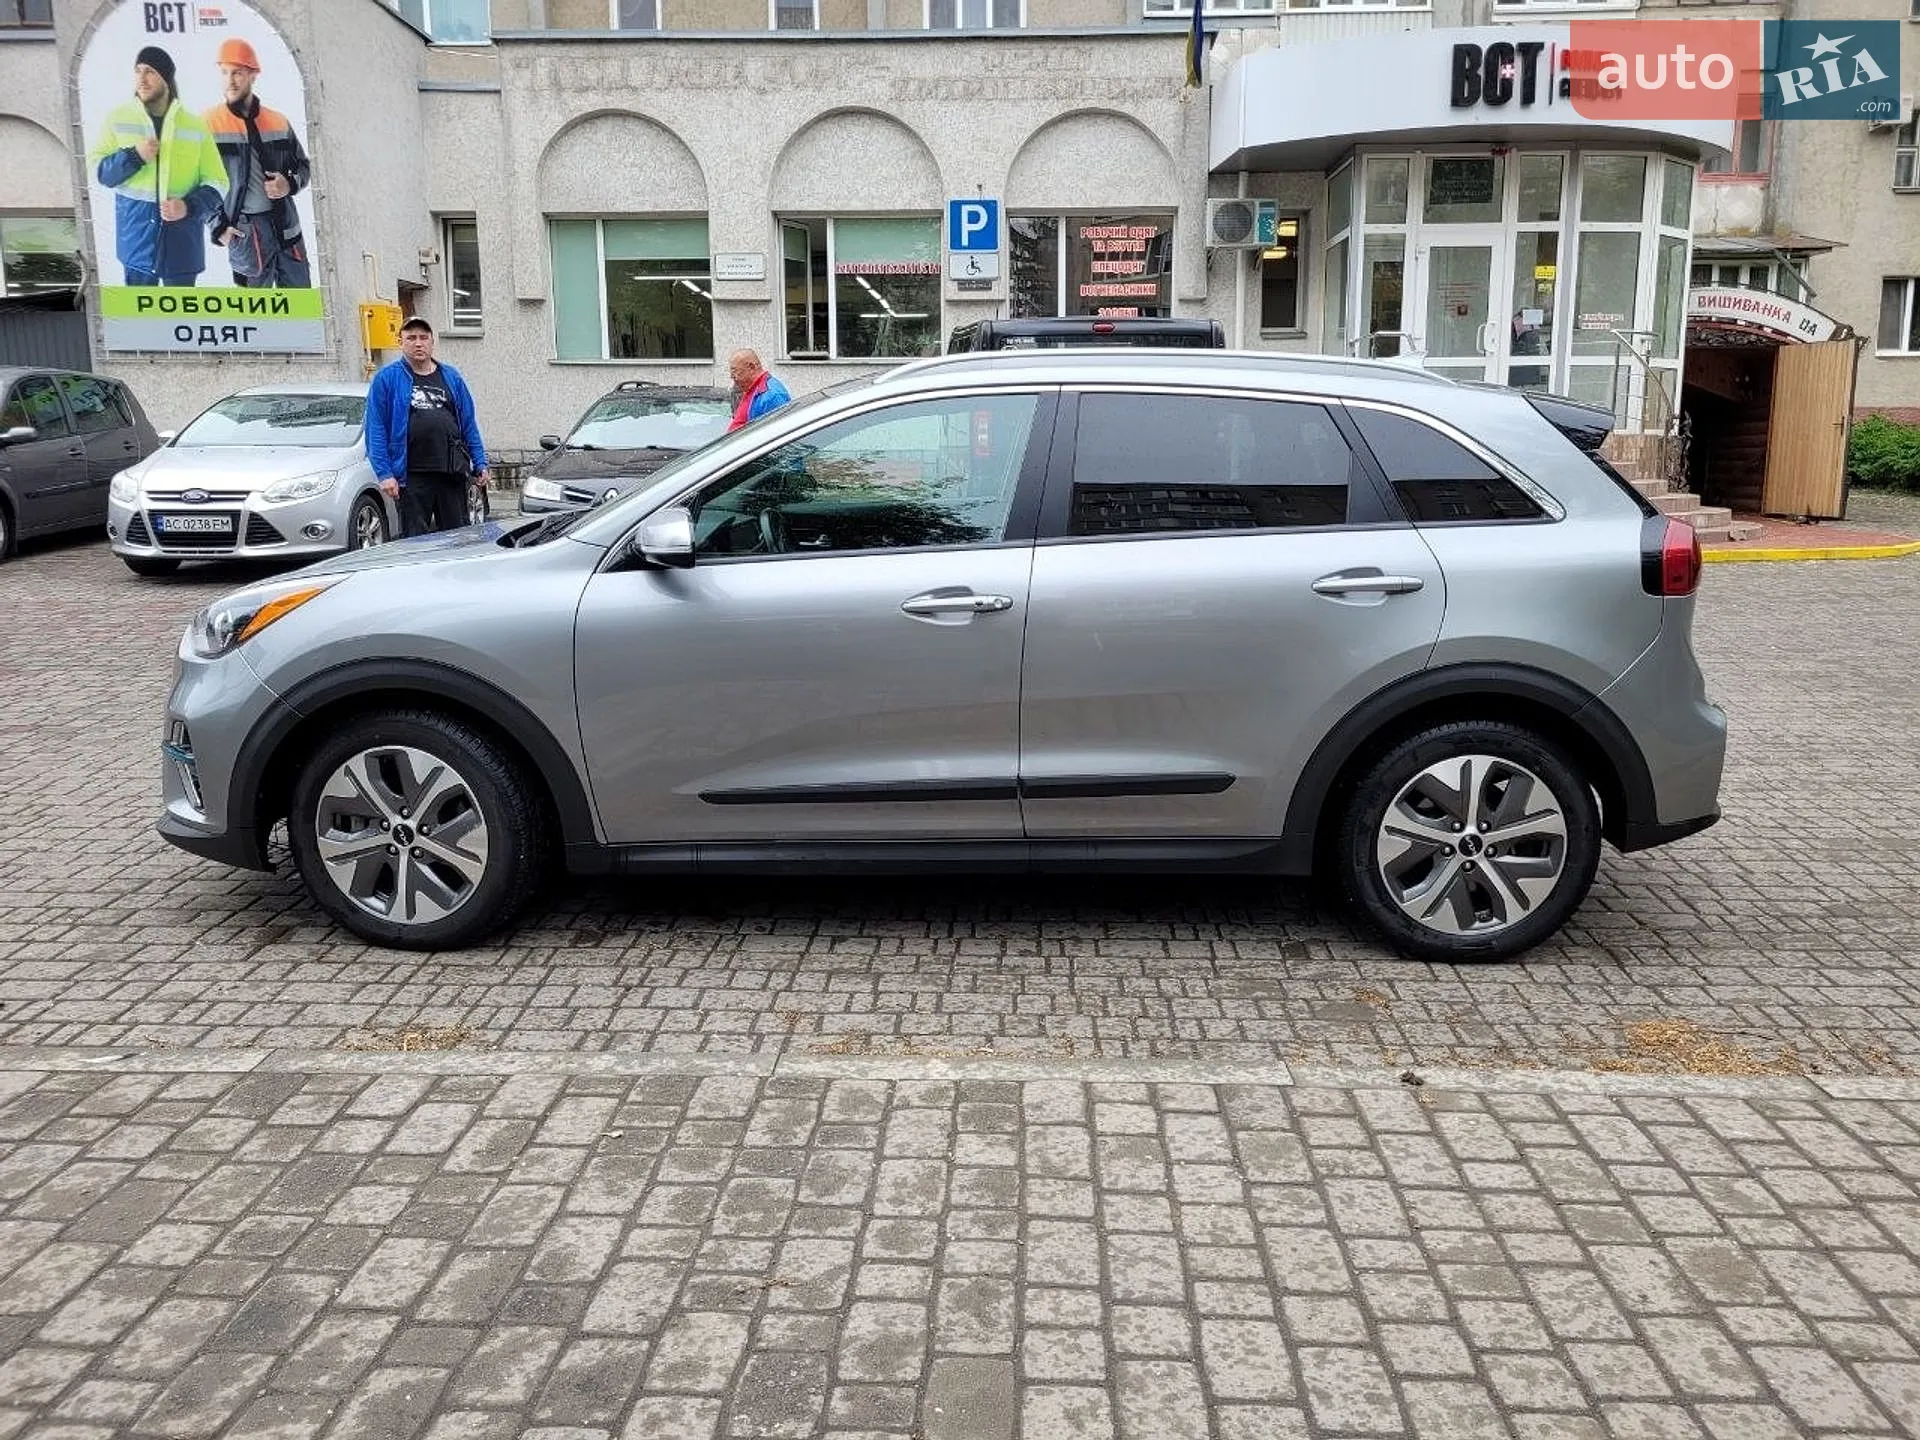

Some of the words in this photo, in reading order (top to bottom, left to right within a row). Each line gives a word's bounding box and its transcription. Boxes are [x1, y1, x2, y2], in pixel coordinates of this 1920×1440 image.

[144, 2, 186, 33] ВСТ
[1451, 42, 1545, 107] ВСТ
[961, 204, 988, 247] P
[137, 293, 290, 314] РОБОЧИЙ
[1698, 295, 1792, 323] ВИШИВАНКА
[174, 325, 258, 346] ОДЯГ
[183, 519, 212, 530] 0238
